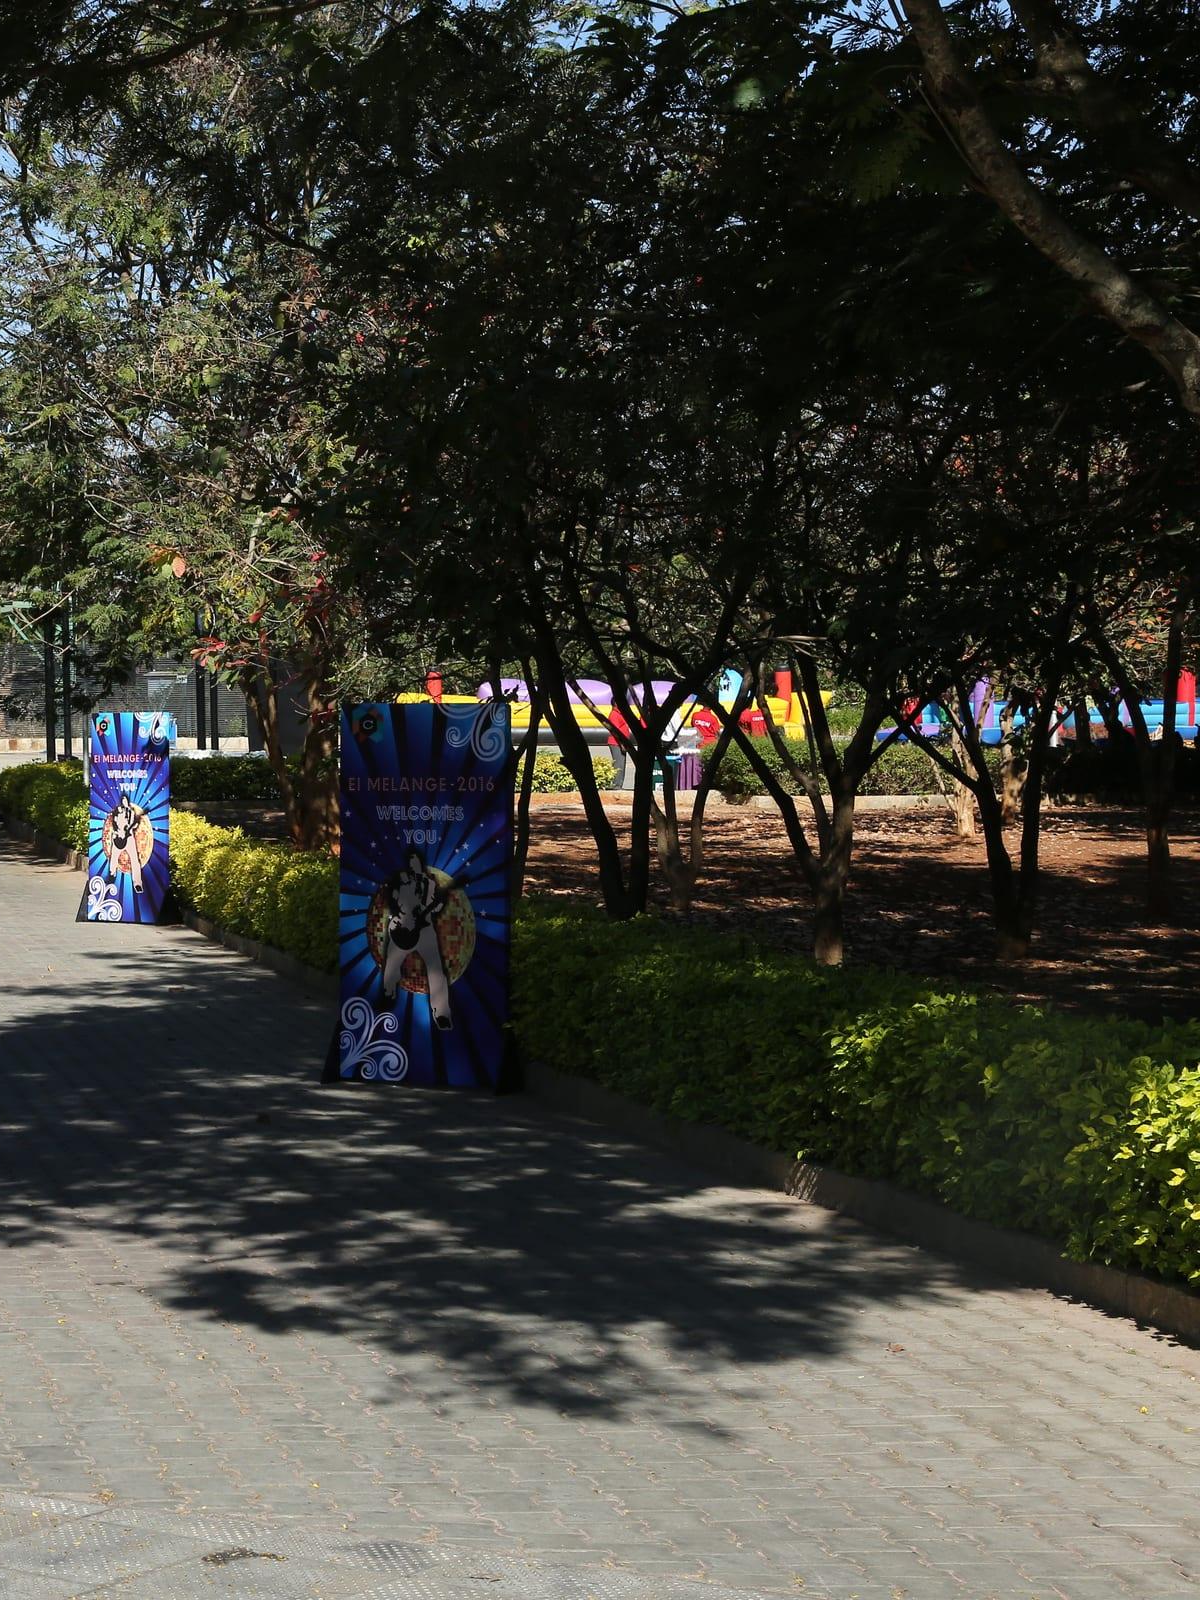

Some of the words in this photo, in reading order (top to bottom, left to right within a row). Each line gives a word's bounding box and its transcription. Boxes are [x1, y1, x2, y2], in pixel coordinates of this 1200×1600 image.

[694, 719, 711, 728] CREW
[106, 769, 148, 779] WELCOMES
[119, 782, 136, 792] YOU
[376, 805, 465, 822] WELCOMES
[403, 829, 438, 845] YOU
